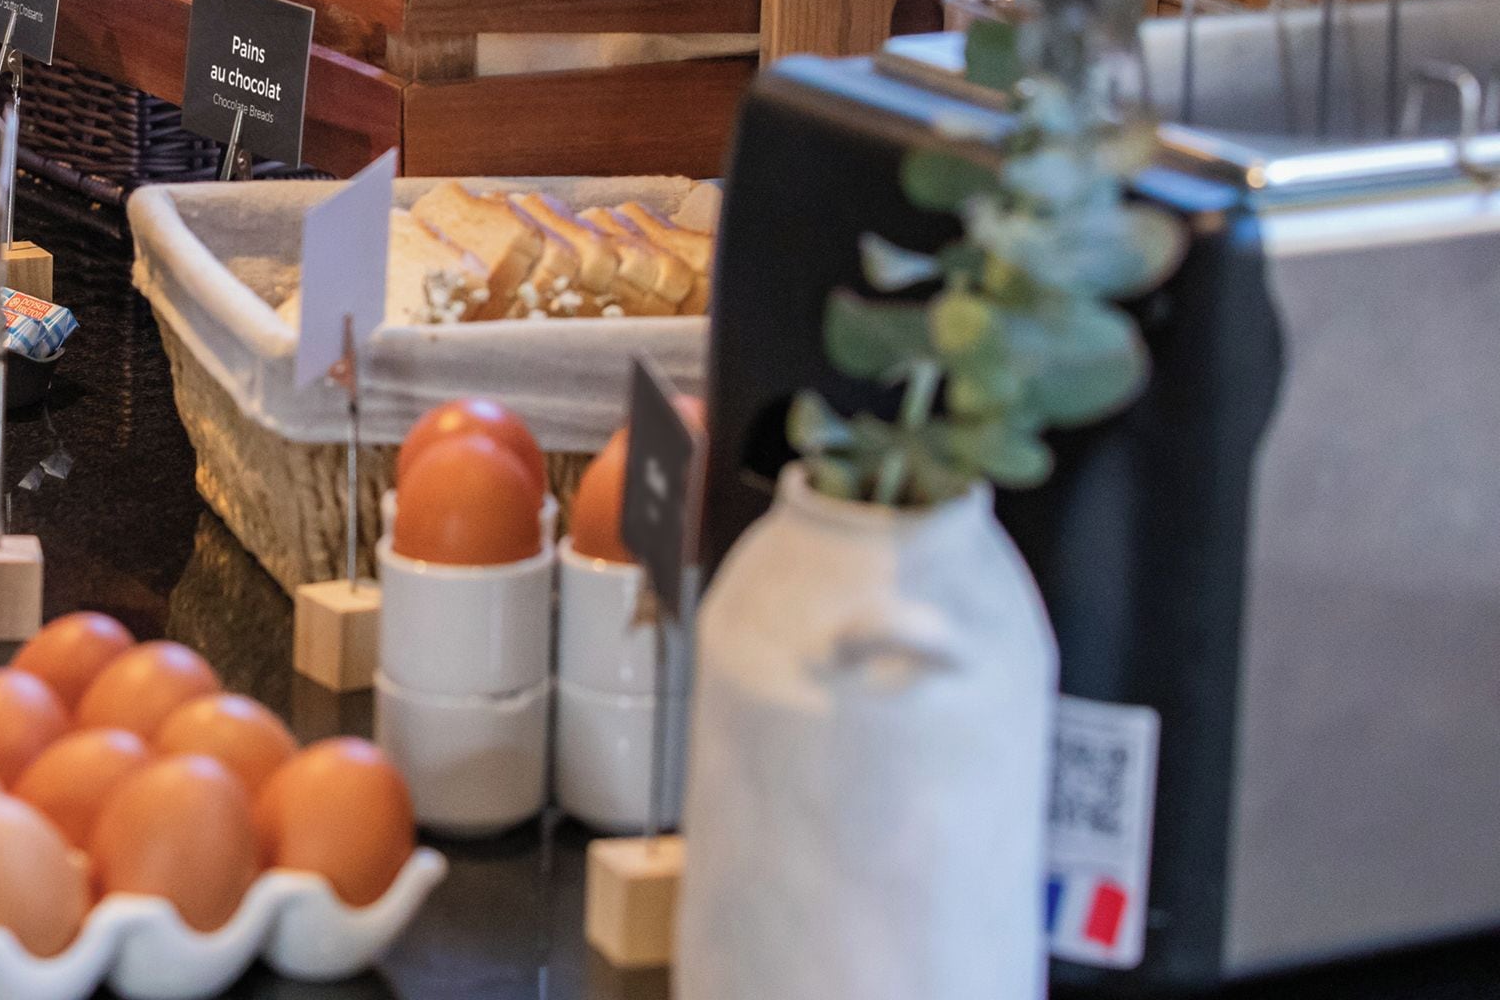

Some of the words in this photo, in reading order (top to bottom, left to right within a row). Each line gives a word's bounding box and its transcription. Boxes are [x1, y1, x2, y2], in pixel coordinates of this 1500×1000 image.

[231, 35, 266, 64] Pains
[210, 64, 226, 83] au
[228, 67, 282, 101] chocolat
[212, 92, 249, 115] Chocolate
[249, 103, 275, 124] Breads
